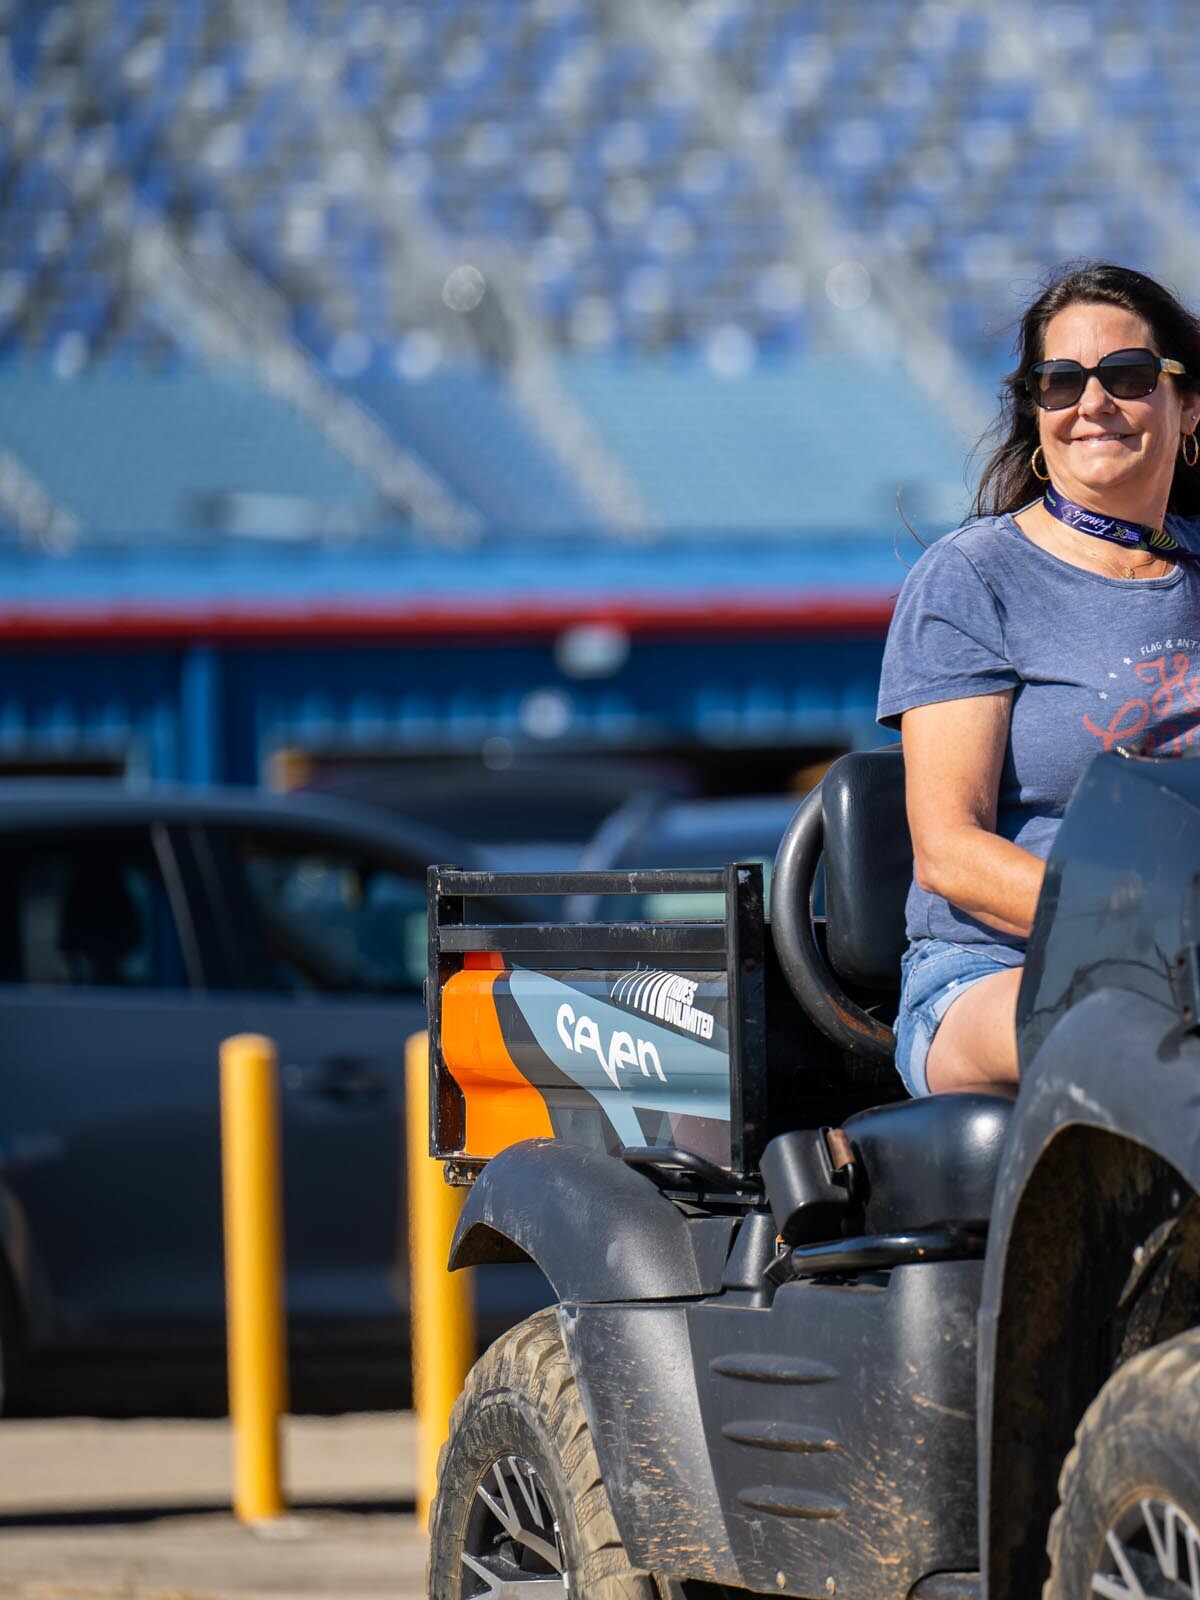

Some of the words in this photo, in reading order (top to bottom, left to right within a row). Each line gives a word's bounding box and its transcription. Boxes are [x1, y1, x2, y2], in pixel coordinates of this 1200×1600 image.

[1140, 641, 1162, 656] FLAG
[1165, 638, 1173, 649] &
[664, 995, 714, 1040] UNLIMITED
